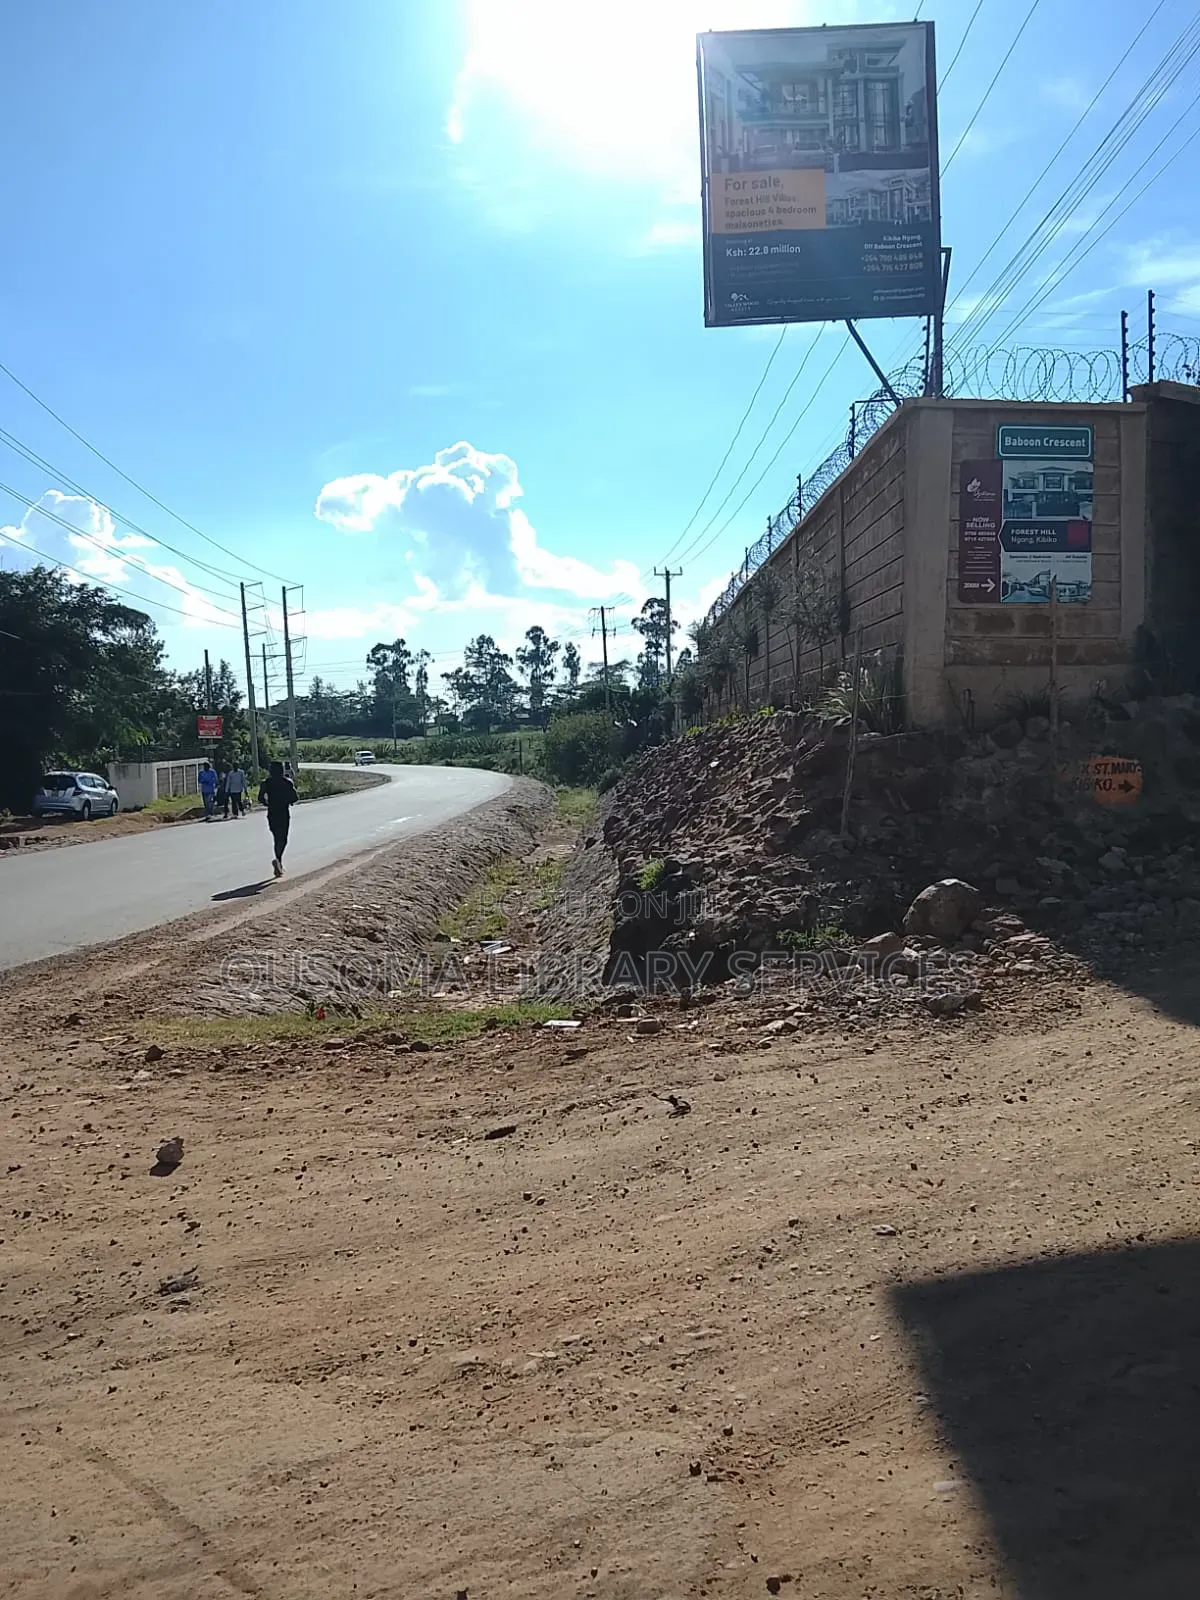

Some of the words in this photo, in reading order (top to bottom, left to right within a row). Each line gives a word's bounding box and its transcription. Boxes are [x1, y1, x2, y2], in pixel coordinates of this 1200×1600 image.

[725, 178, 748, 191] For
[752, 176, 784, 190] sale,
[725, 196, 754, 206] Forest
[756, 195, 770, 204] Hill
[725, 208, 766, 218] spacious
[776, 205, 817, 215] bedroom
[726, 247, 747, 257] Ksh:
[770, 244, 801, 254] million
[1004, 436, 1041, 447] Baboon
[1043, 436, 1086, 447] Crescent
